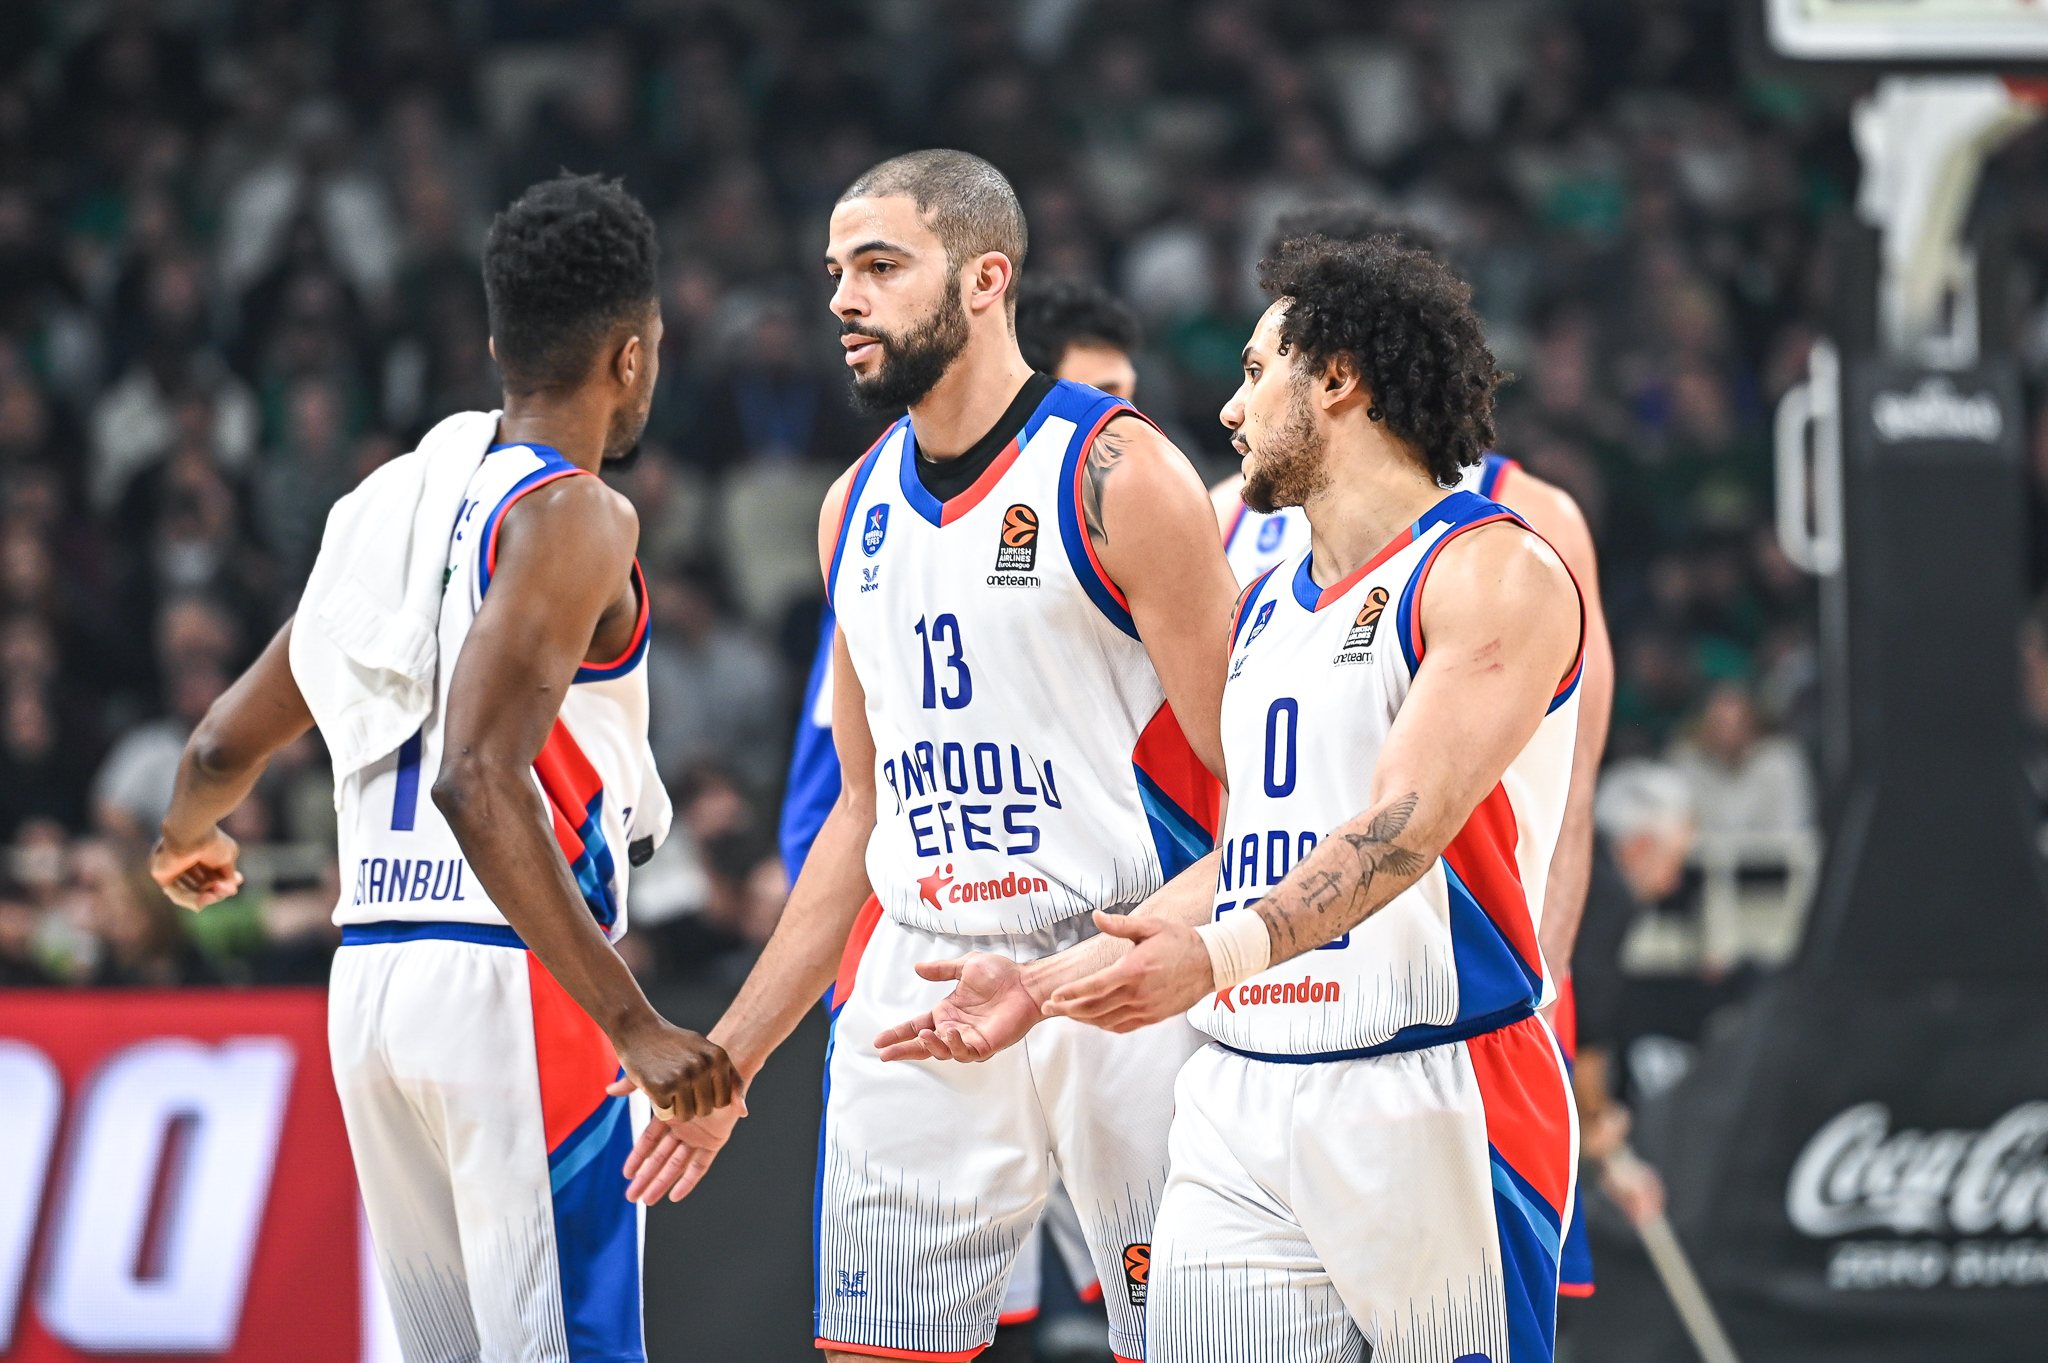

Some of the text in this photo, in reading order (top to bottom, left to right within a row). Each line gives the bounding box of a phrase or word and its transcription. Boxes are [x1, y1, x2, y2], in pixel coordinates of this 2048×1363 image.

[999, 554, 1031, 562] AIRLINES
[1000, 547, 1032, 555] TURKISH
[986, 574, 1041, 588] oneteam
[914, 613, 972, 710] 13
[1264, 697, 1298, 798] 0
[884, 741, 1062, 816] ANADOLU
[909, 801, 1040, 857] EFES
[1217, 830, 1329, 894] NADO
[949, 872, 1048, 904] corendon
[1239, 976, 1341, 1006] corendon
[1130, 1283, 1147, 1291] TUR
[1131, 1290, 1146, 1298] AIR
